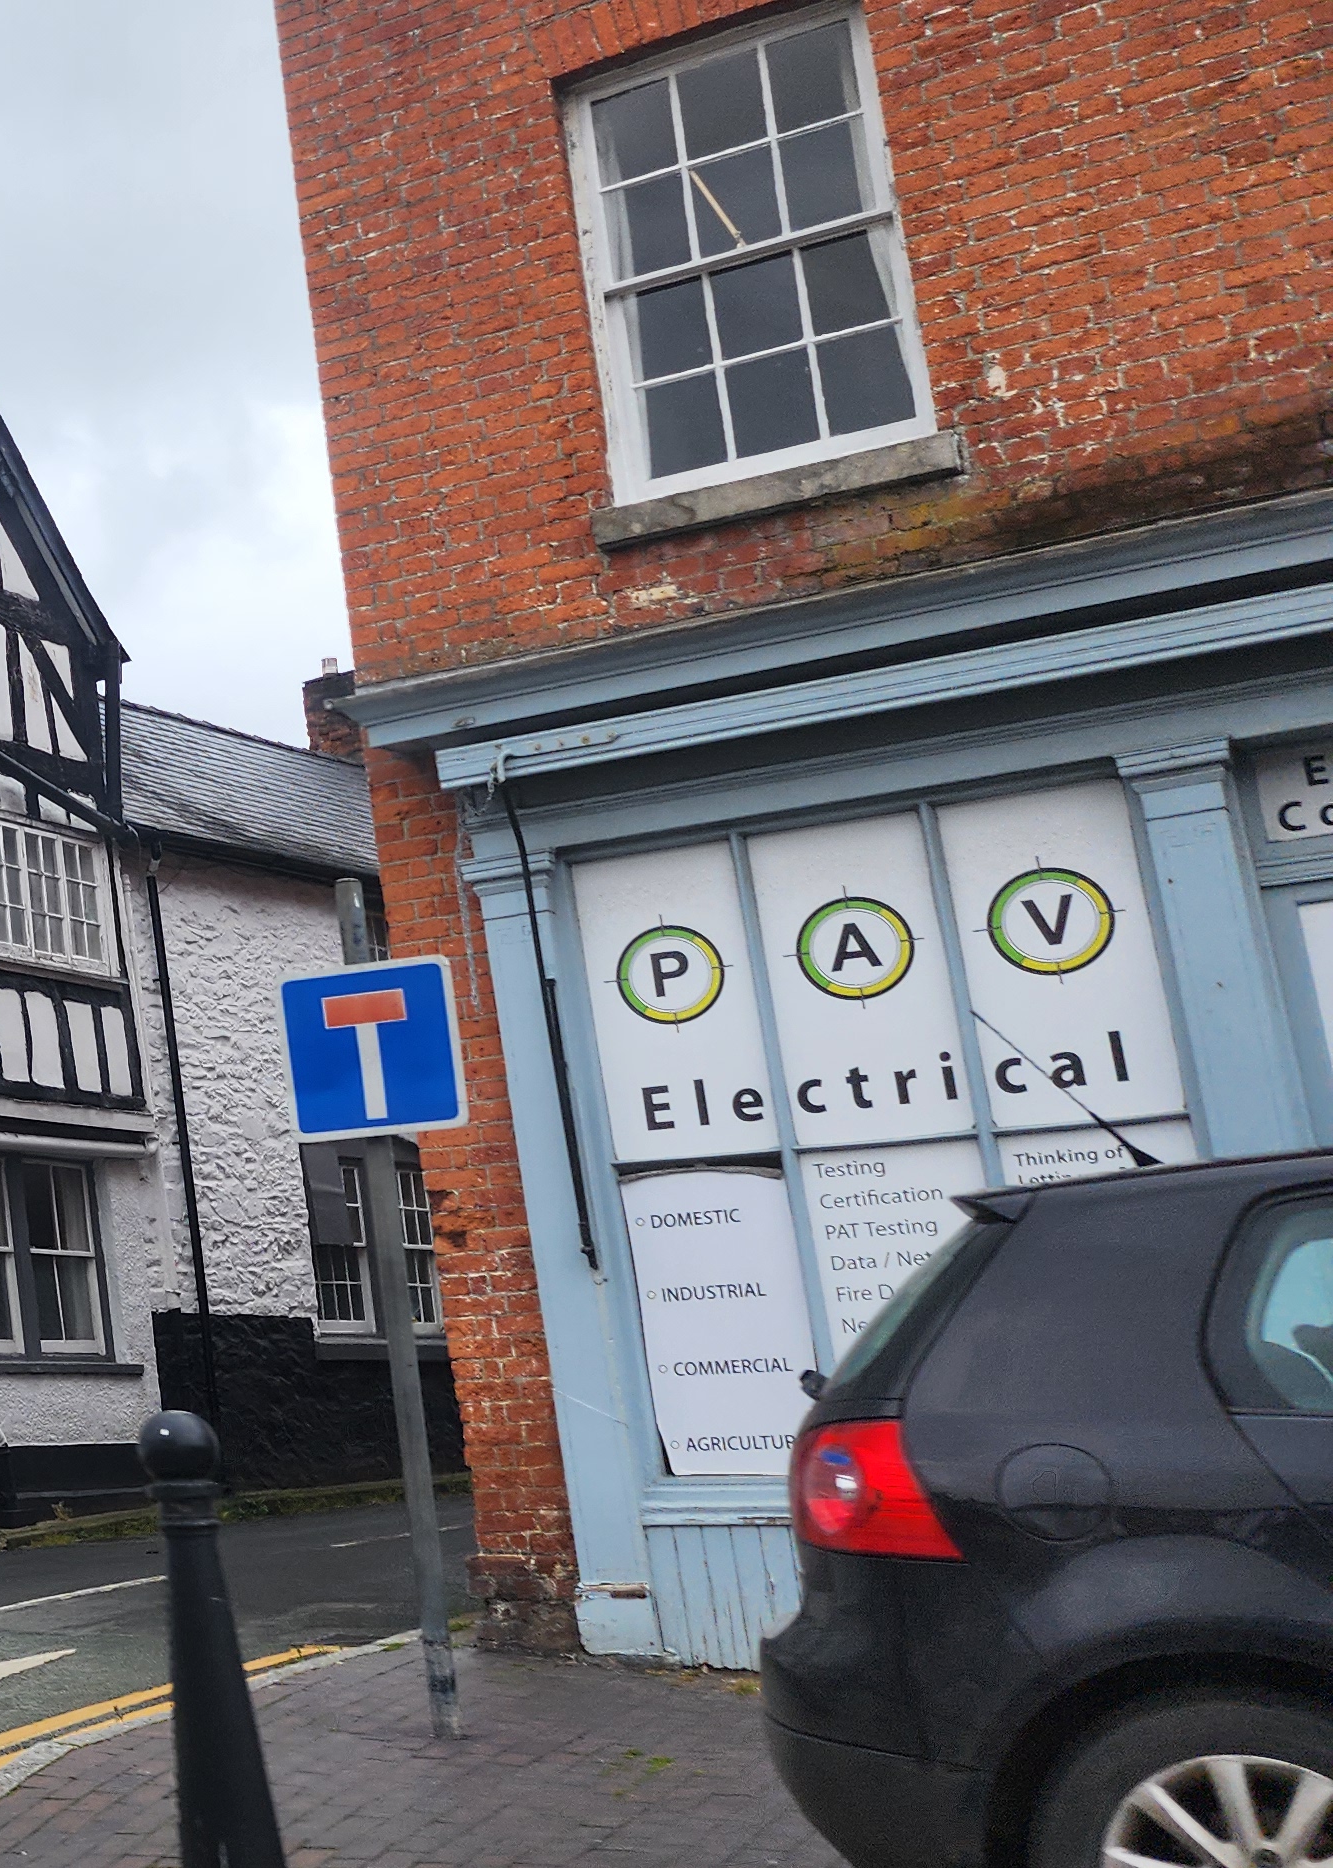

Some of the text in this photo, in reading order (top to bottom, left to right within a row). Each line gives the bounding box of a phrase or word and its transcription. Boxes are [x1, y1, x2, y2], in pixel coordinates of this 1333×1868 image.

[641, 1030, 1130, 1131] Electrical
[1013, 1144, 1126, 1167] Thinking of
[812, 1160, 886, 1179] Testing
[820, 1188, 944, 1209] Certification
[650, 1208, 741, 1229] DOMESTIC
[824, 1219, 938, 1240] PAT Testing
[831, 1255, 878, 1271] Data
[661, 1282, 767, 1302] INDUSTRIAL
[836, 1286, 873, 1302] Fire
[842, 1317, 868, 1333] Ne
[673, 1357, 794, 1377] COMMERCIAL
[686, 1434, 795, 1452] AGRICULTUR
